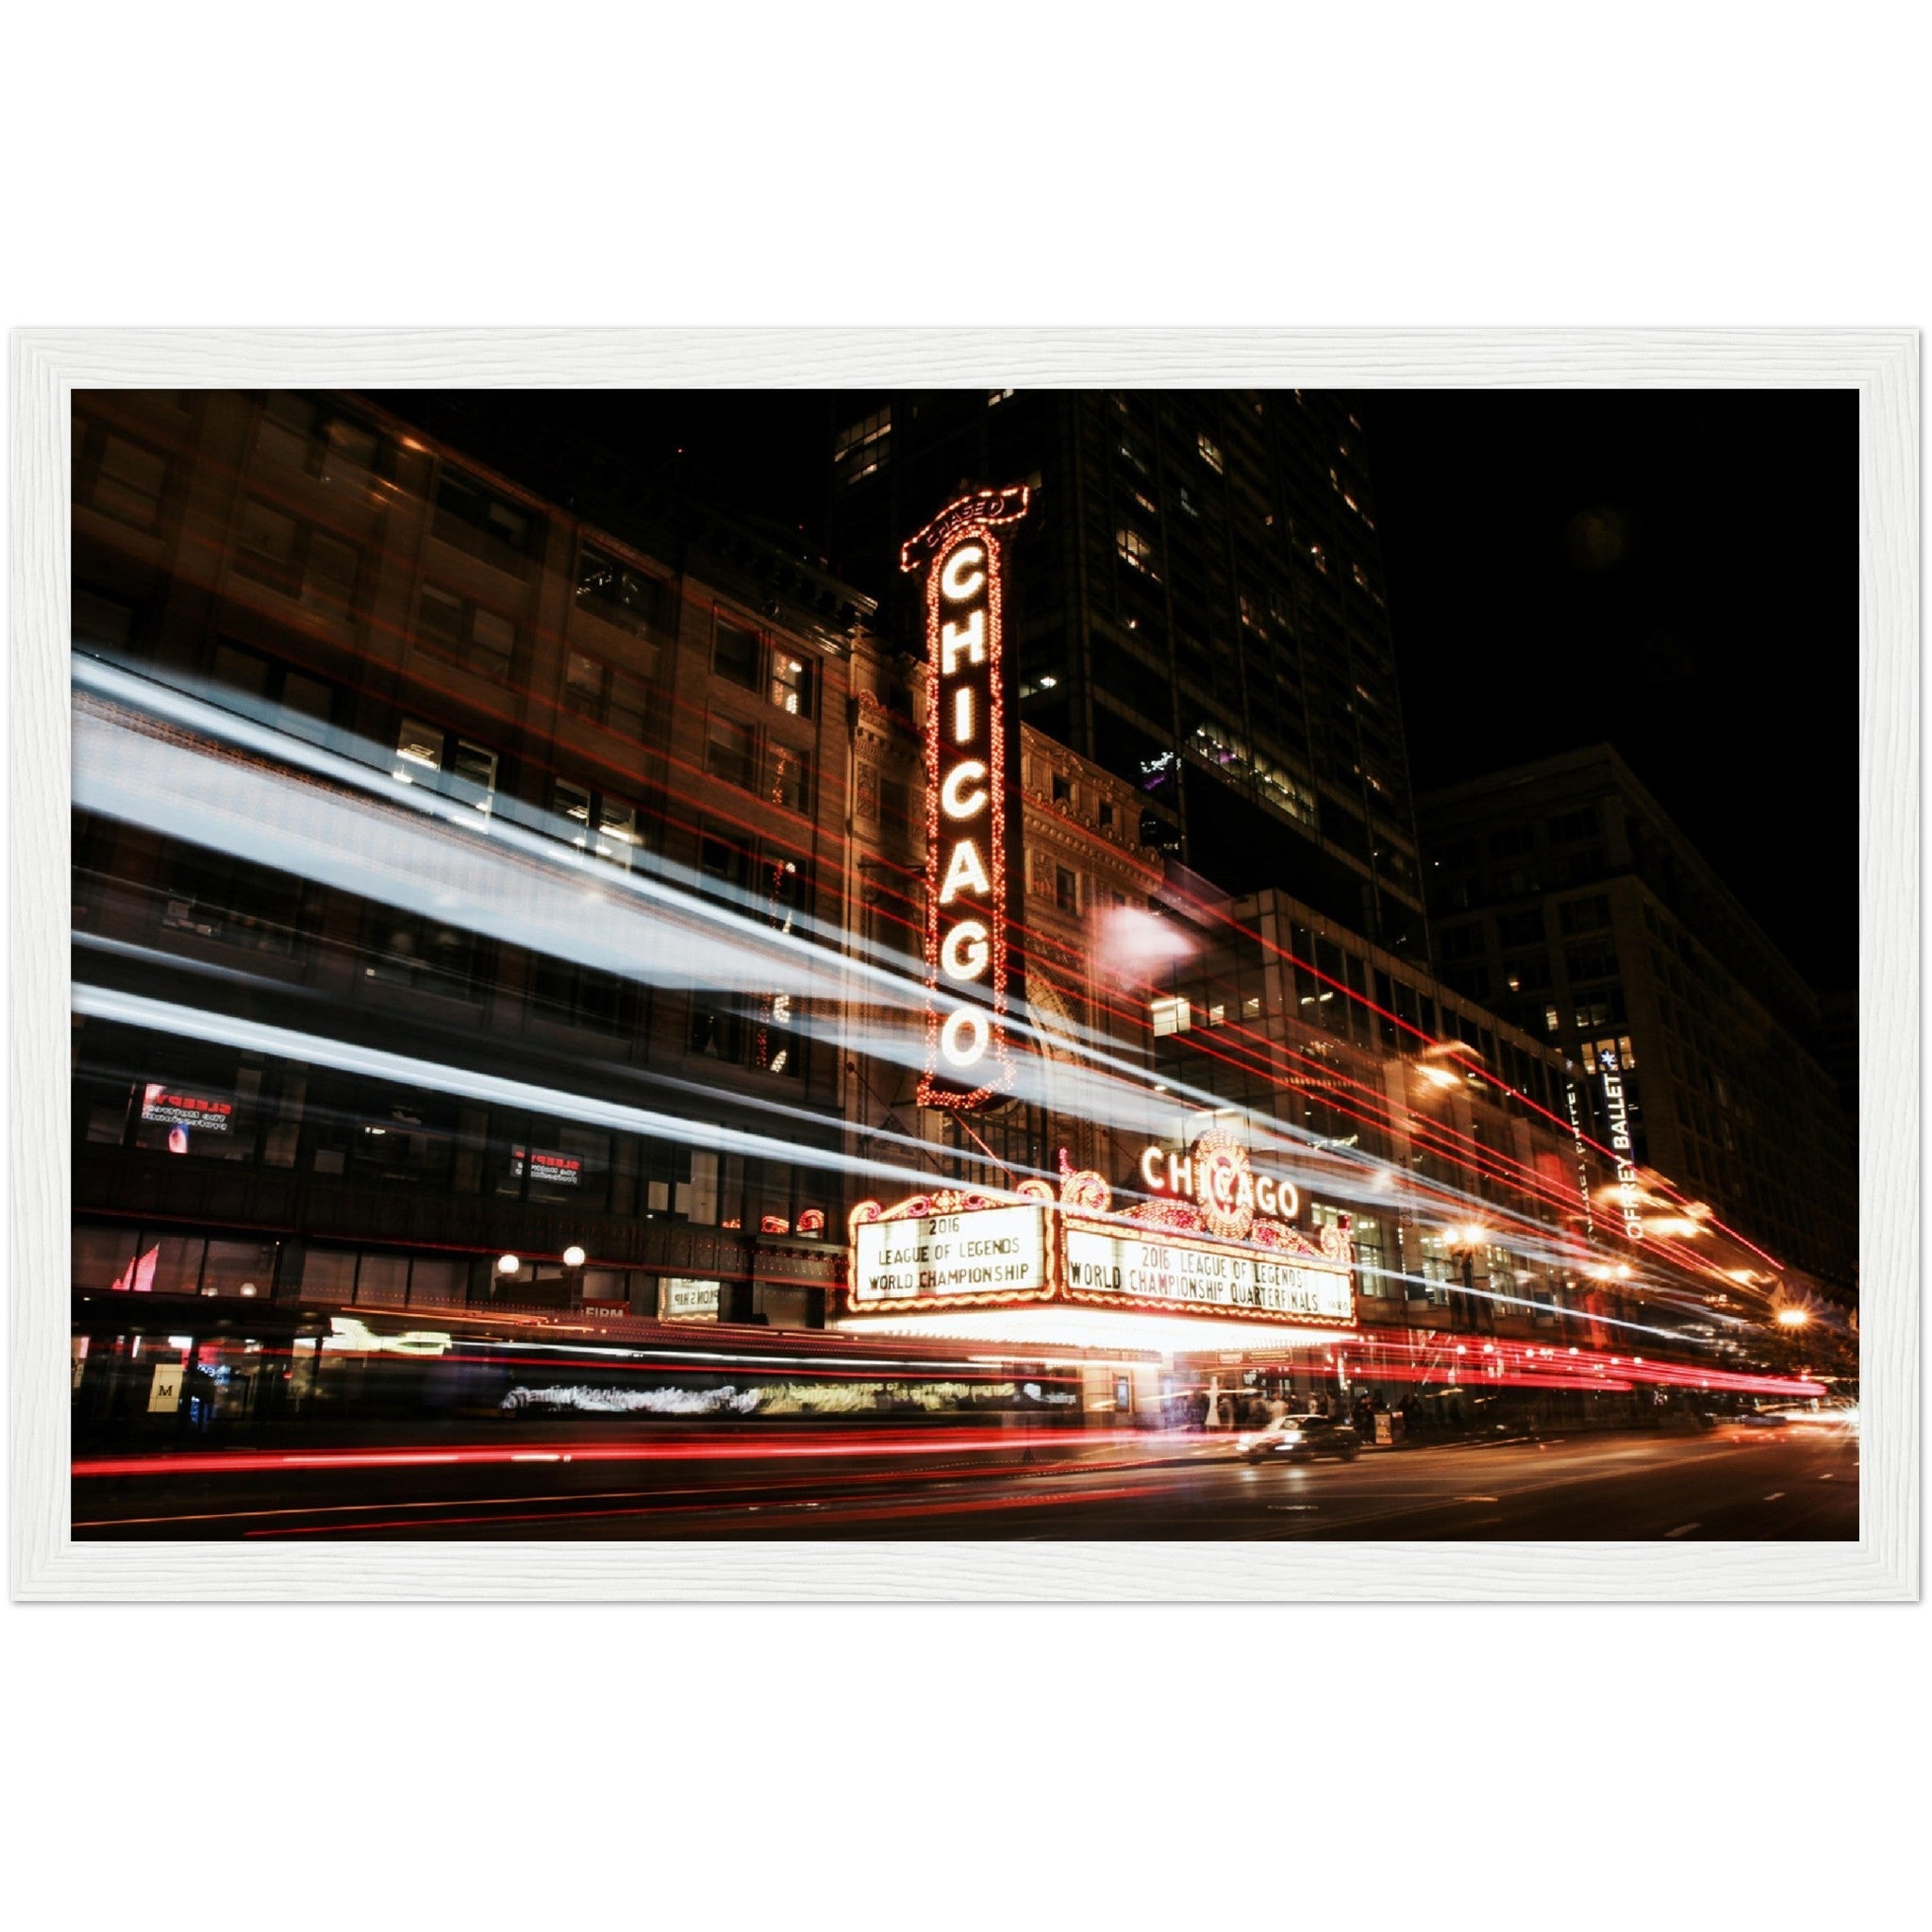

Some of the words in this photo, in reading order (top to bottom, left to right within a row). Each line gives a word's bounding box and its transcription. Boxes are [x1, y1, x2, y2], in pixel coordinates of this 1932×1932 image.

[941, 545, 990, 1068] CHICAGO
[1605, 1072, 1631, 1150] BALLET
[1141, 1146, 1299, 1218] CHICAGO
[928, 1217, 959, 1236] 2016
[878, 1245, 929, 1266] LEAGUE
[934, 1243, 951, 1260] OF
[958, 1238, 1021, 1258] LEGENDS
[1141, 1245, 1171, 1271] 2016
[1181, 1250, 1227, 1278] LEAGUE
[1233, 1260, 1247, 1279] OF
[1255, 1262, 1303, 1289] LEGENDS
[868, 1274, 913, 1291] WORLD
[919, 1262, 1029, 1289] CHAMPIONSHIP
[1071, 1261, 1121, 1290] WORLD
[1130, 1270, 1224, 1300] CHAMPIONSHIP
[1229, 1282, 1319, 1311] QUARTERFINALS
[158, 1385, 173, 1396] M
